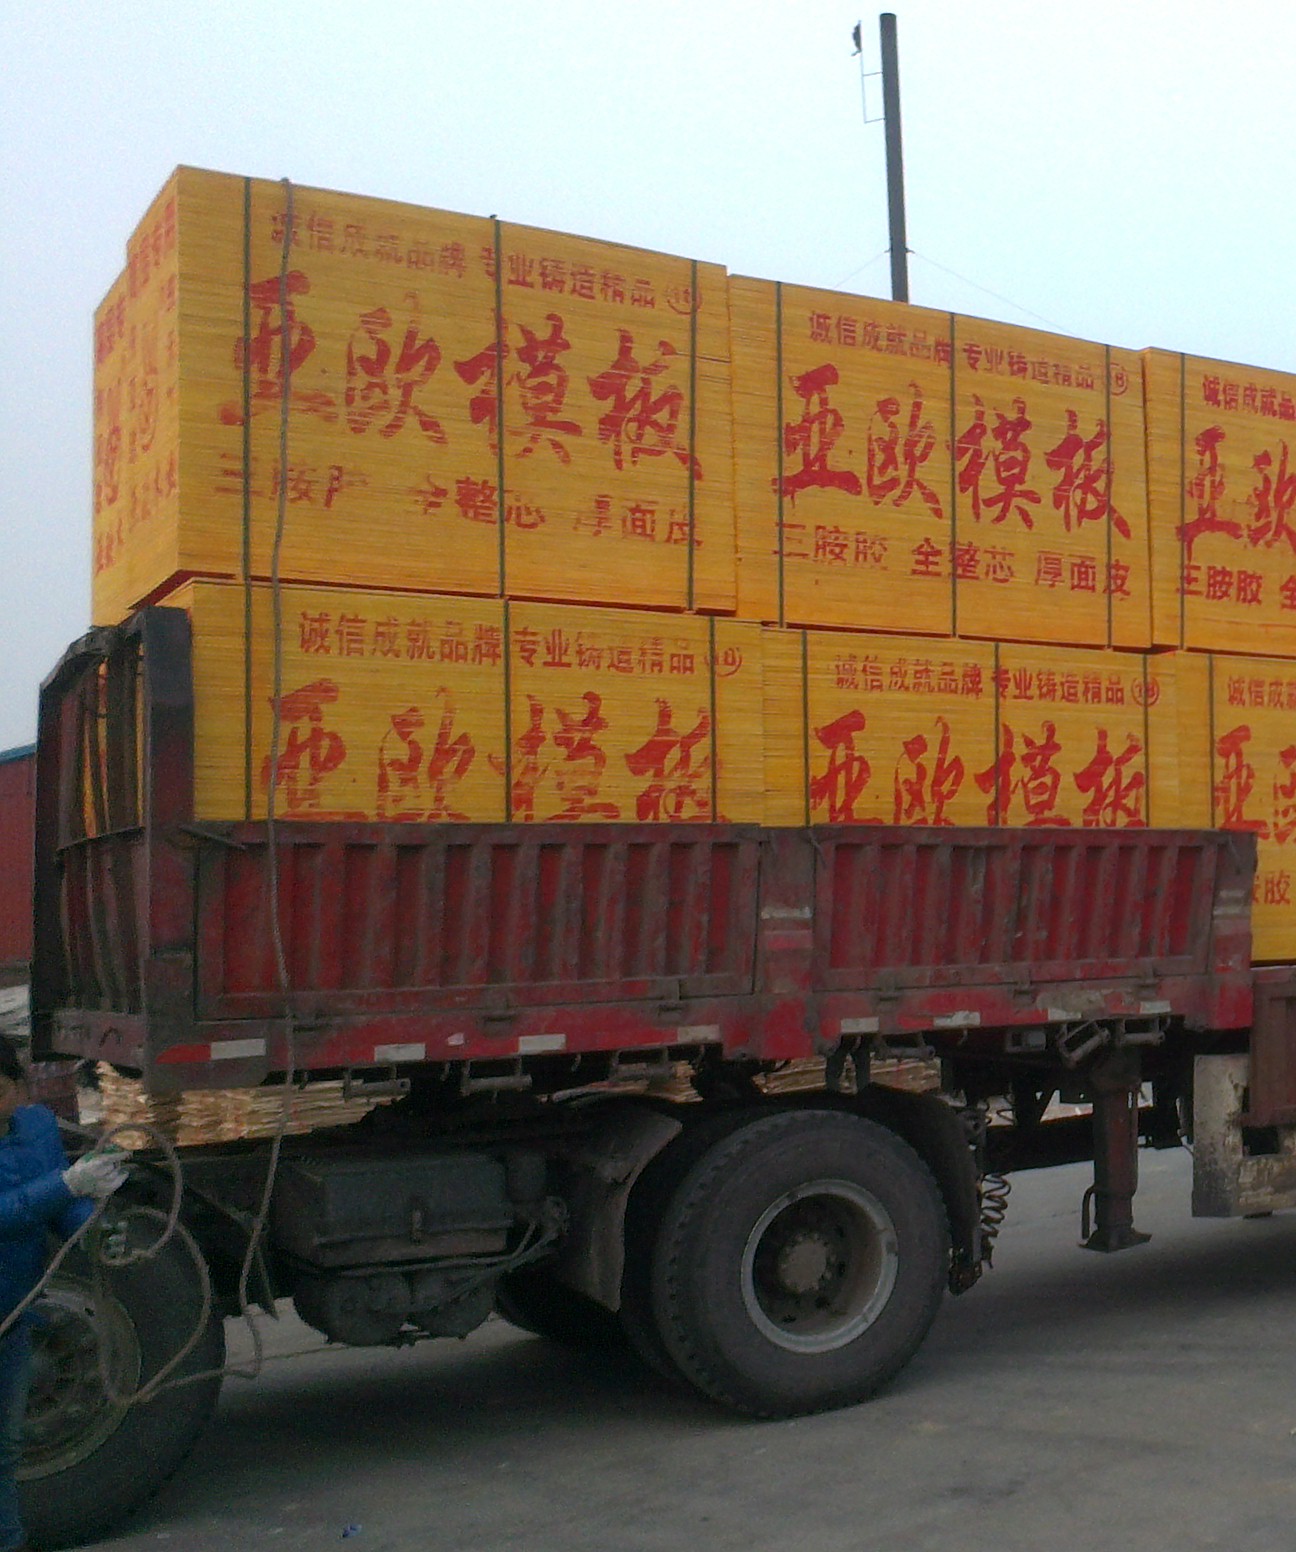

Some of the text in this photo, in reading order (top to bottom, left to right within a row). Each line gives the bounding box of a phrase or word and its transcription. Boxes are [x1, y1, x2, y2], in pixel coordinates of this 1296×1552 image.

[910, 537, 1016, 584] 全整芯
[299, 609, 695, 675] 诚信成就品牌 专业铸造精品
[833, 653, 1125, 705] 诚信成就品牌 专业铸造精品
